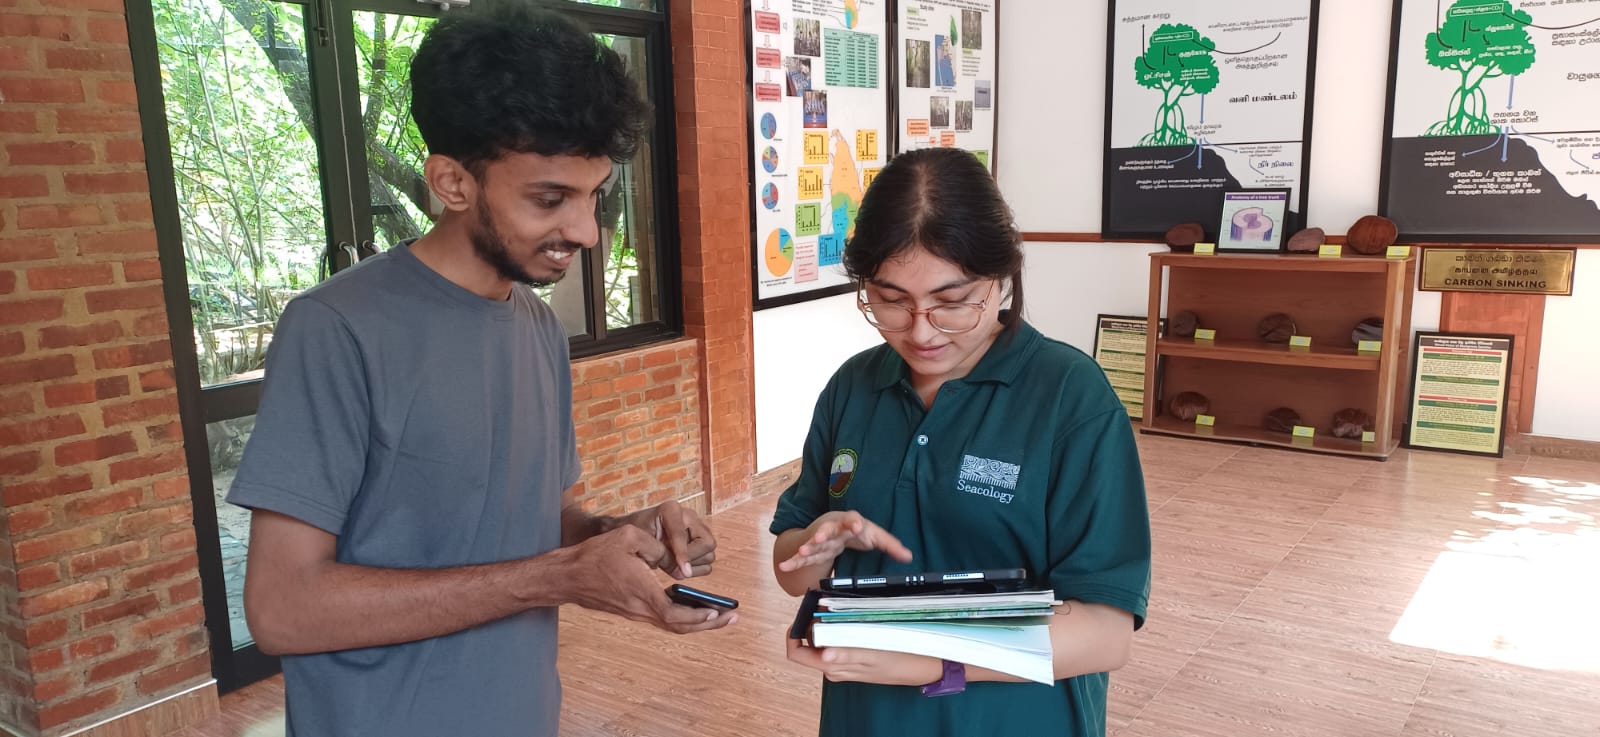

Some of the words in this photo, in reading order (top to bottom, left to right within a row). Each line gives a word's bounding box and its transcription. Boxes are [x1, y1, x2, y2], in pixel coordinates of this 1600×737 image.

[1252, 91, 1298, 102] மண்டலம்
[1444, 278, 1492, 287] CARBON
[1496, 279, 1547, 289] SINKING
[957, 479, 1014, 504] Seacology
